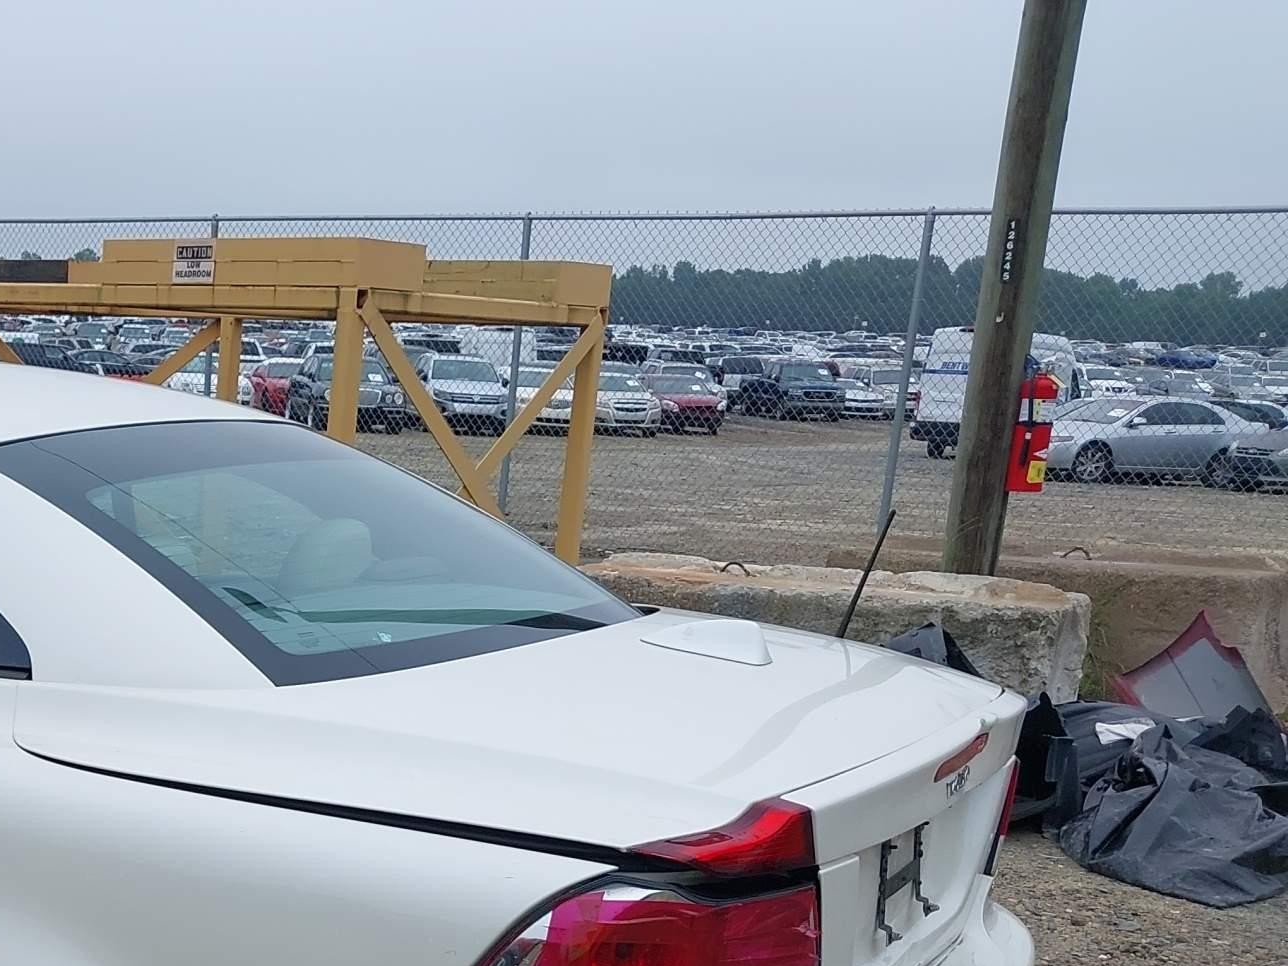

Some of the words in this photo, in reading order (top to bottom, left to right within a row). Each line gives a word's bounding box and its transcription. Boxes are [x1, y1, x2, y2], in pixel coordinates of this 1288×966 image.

[177, 246, 213, 258] CAUTION
[1002, 220, 1016, 281] 126245
[186, 261, 201, 269] LOW
[175, 270, 212, 278] HEADROOM
